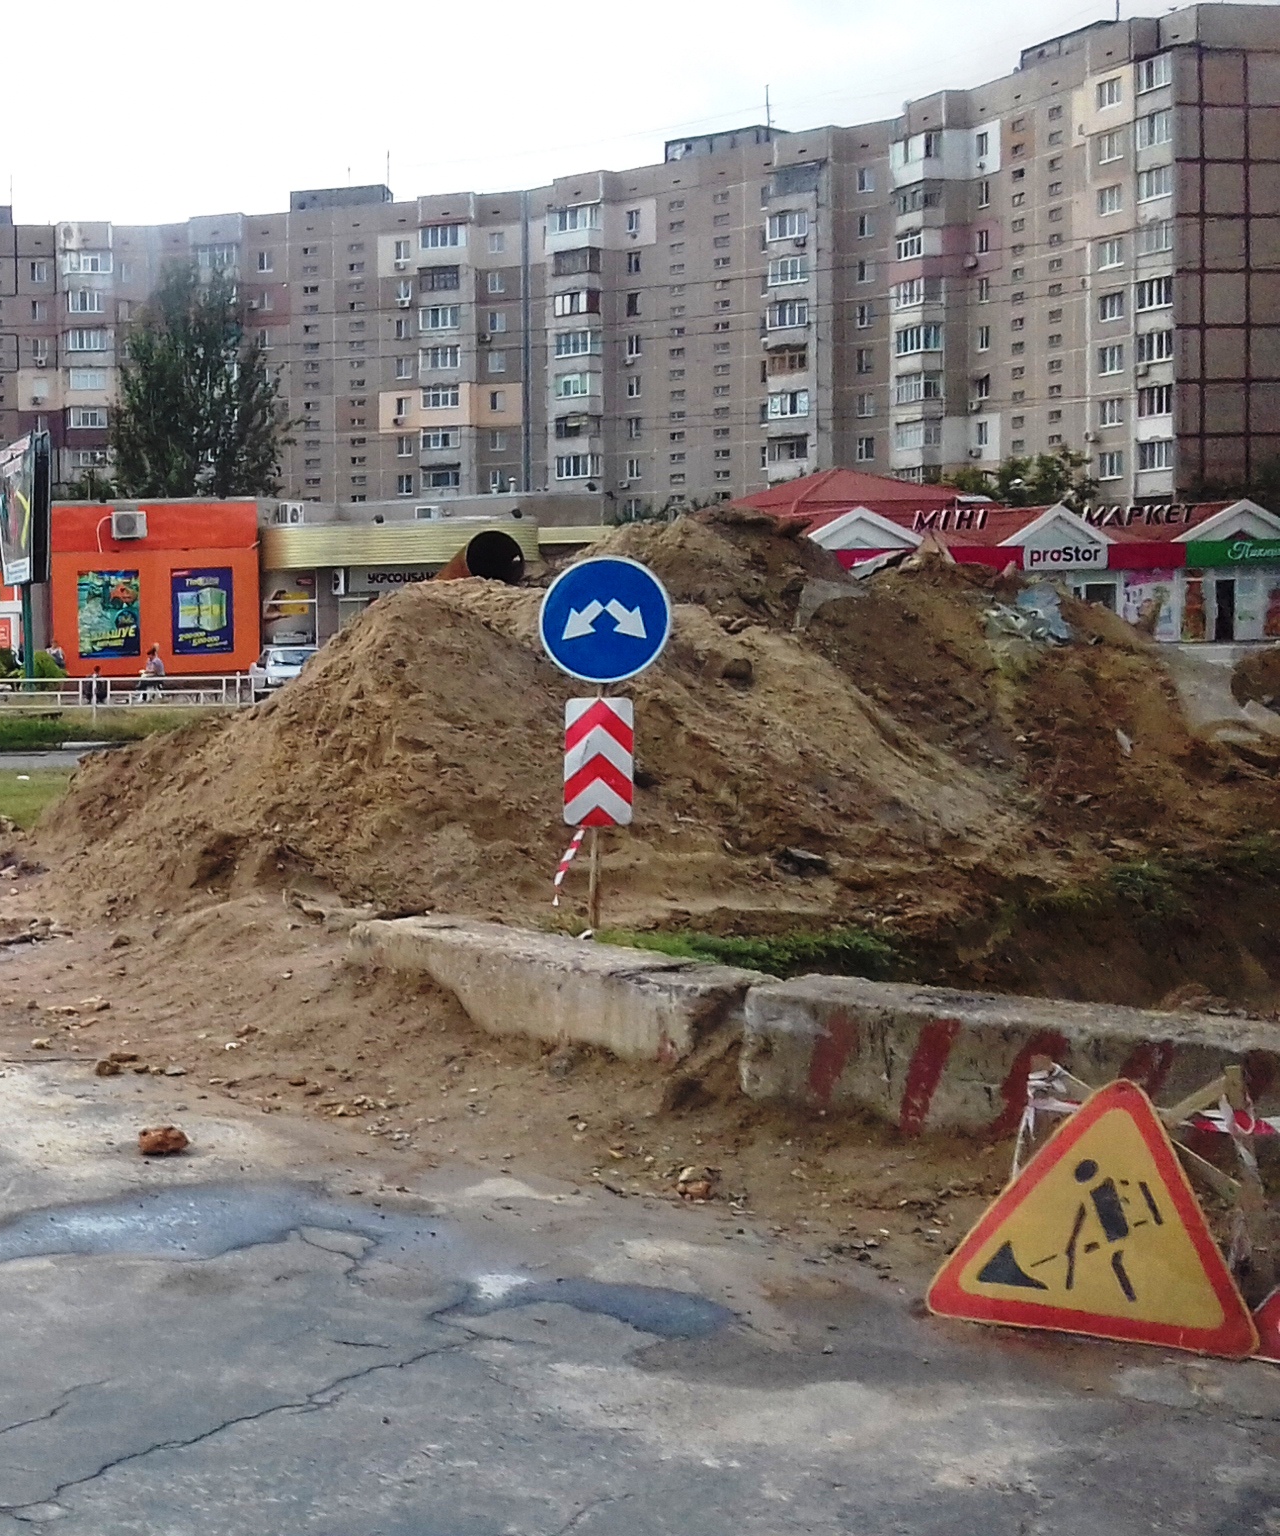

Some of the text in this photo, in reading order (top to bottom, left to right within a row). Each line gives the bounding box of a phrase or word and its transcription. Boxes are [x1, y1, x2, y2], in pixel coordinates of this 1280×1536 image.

[913, 504, 1198, 531] МІНІ МАРКЕТ
[1030, 546, 1101, 567] proStor
[367, 571, 437, 584] УКРСОЦБАН
